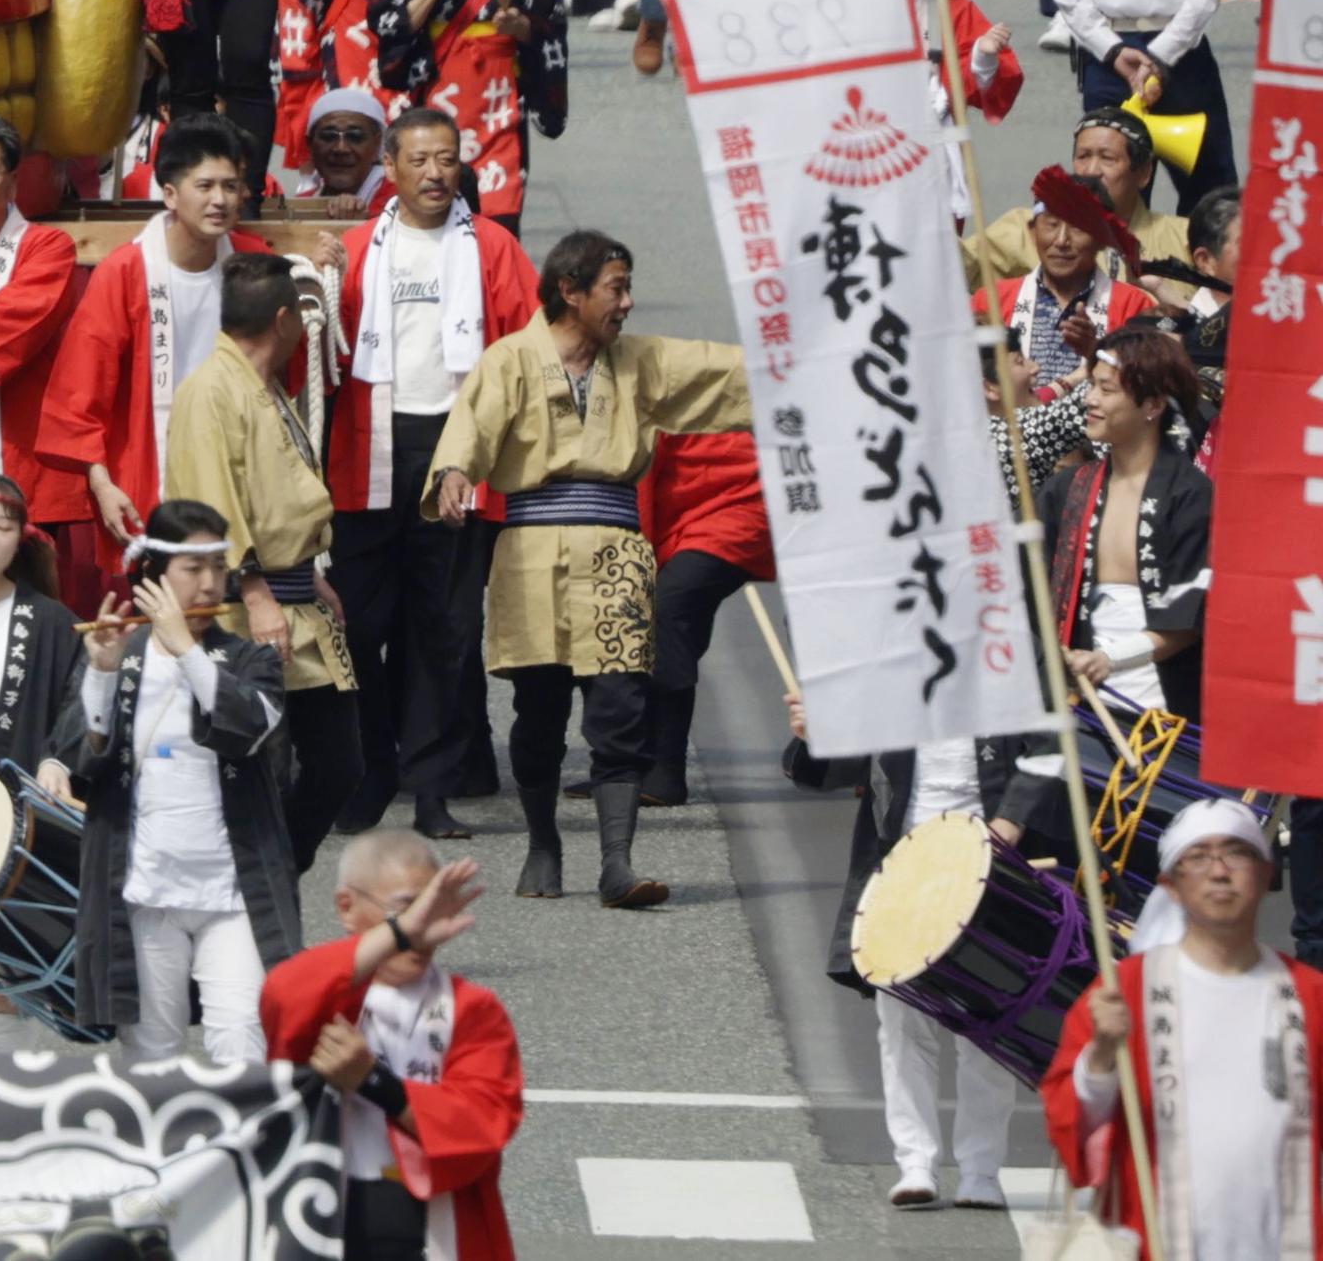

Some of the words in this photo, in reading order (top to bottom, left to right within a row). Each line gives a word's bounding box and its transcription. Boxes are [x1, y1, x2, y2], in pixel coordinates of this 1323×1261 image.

[149, 285, 171, 390] 城島まつり
